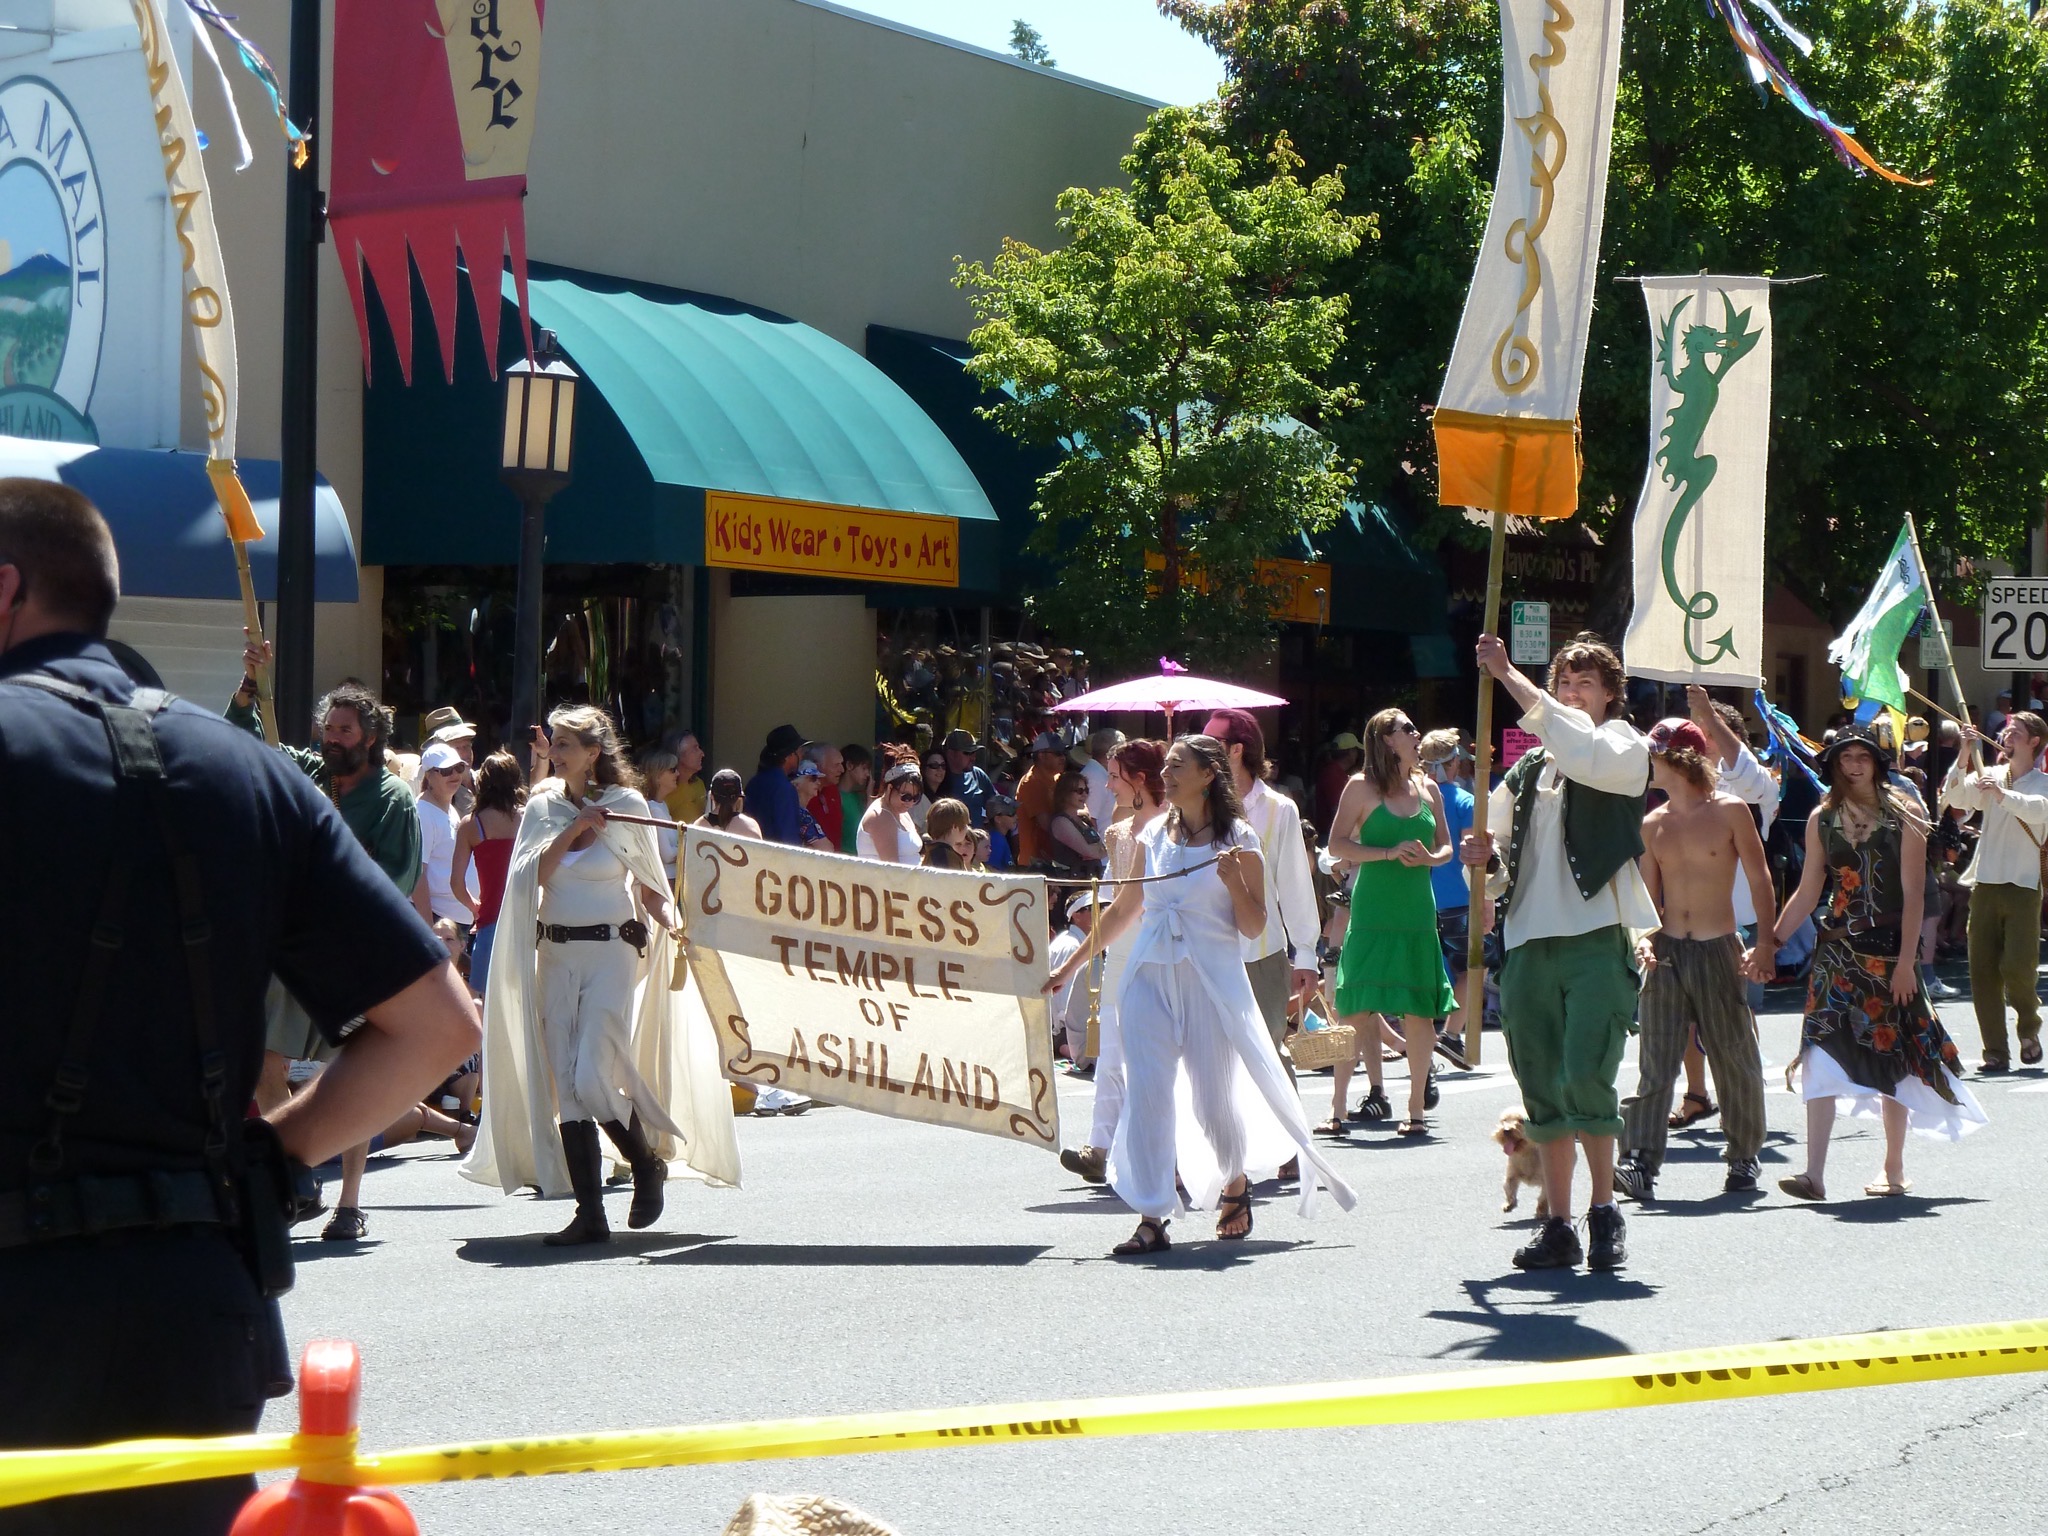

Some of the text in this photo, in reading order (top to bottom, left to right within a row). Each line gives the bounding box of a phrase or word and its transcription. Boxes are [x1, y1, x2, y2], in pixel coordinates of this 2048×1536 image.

[36, 98, 101, 308] MALL
[715, 509, 951, 569] Kids Wear Toys Art
[1991, 611, 2048, 661] 20
[755, 868, 980, 947] GODDESS
[771, 935, 973, 1003] TEMPLE
[859, 998, 910, 1032] OF
[786, 1027, 1001, 1112] ASHLAND
